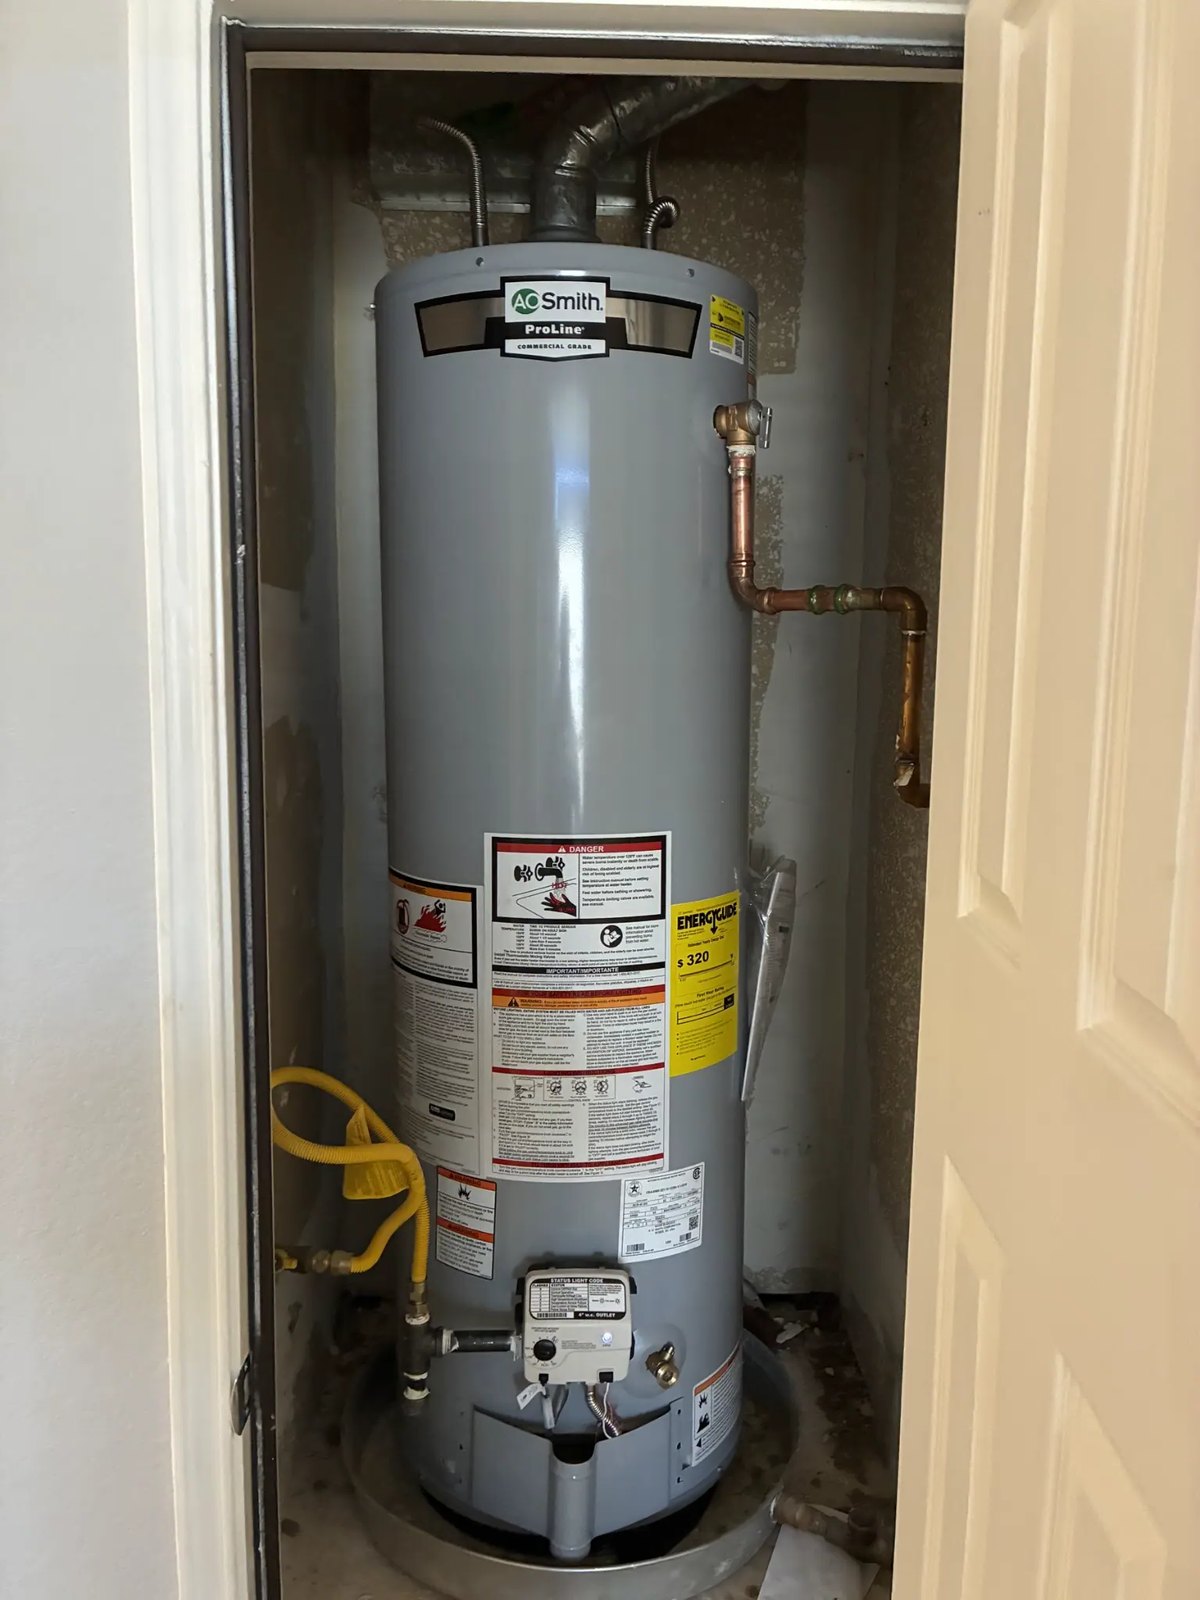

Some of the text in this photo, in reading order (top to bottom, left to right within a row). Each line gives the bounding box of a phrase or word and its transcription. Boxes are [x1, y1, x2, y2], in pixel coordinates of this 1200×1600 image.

[677, 902, 737, 930] ENERGYGUIDE
[677, 951, 709, 968] $ 320
